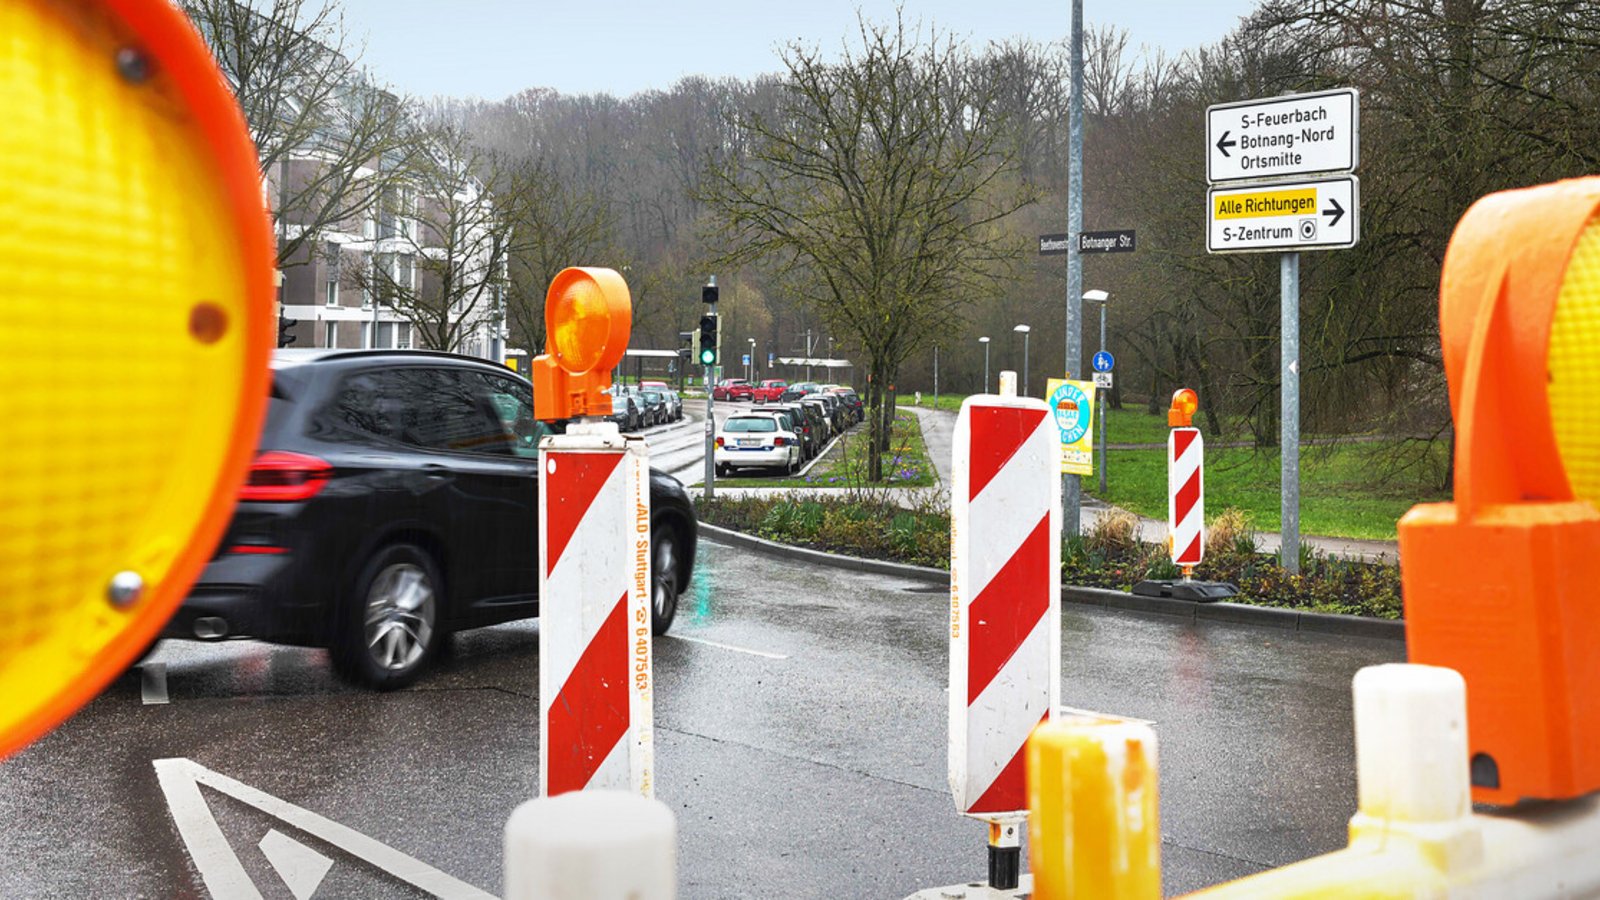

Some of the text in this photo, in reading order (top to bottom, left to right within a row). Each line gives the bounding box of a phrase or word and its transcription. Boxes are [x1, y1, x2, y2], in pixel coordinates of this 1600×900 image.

[1241, 106, 1327, 129] S-Feuerbach
[1241, 126, 1335, 149] Botnang-Nord
[1241, 152, 1302, 170] Ortsmitte
[1218, 197, 1315, 215] Alle Richtungen
[1082, 234, 1133, 251] Botnanger Str.
[1223, 226, 1293, 242] S-Zentrum
[634, 540, 649, 599] Stuttgart
[636, 627, 648, 690] 6407563
